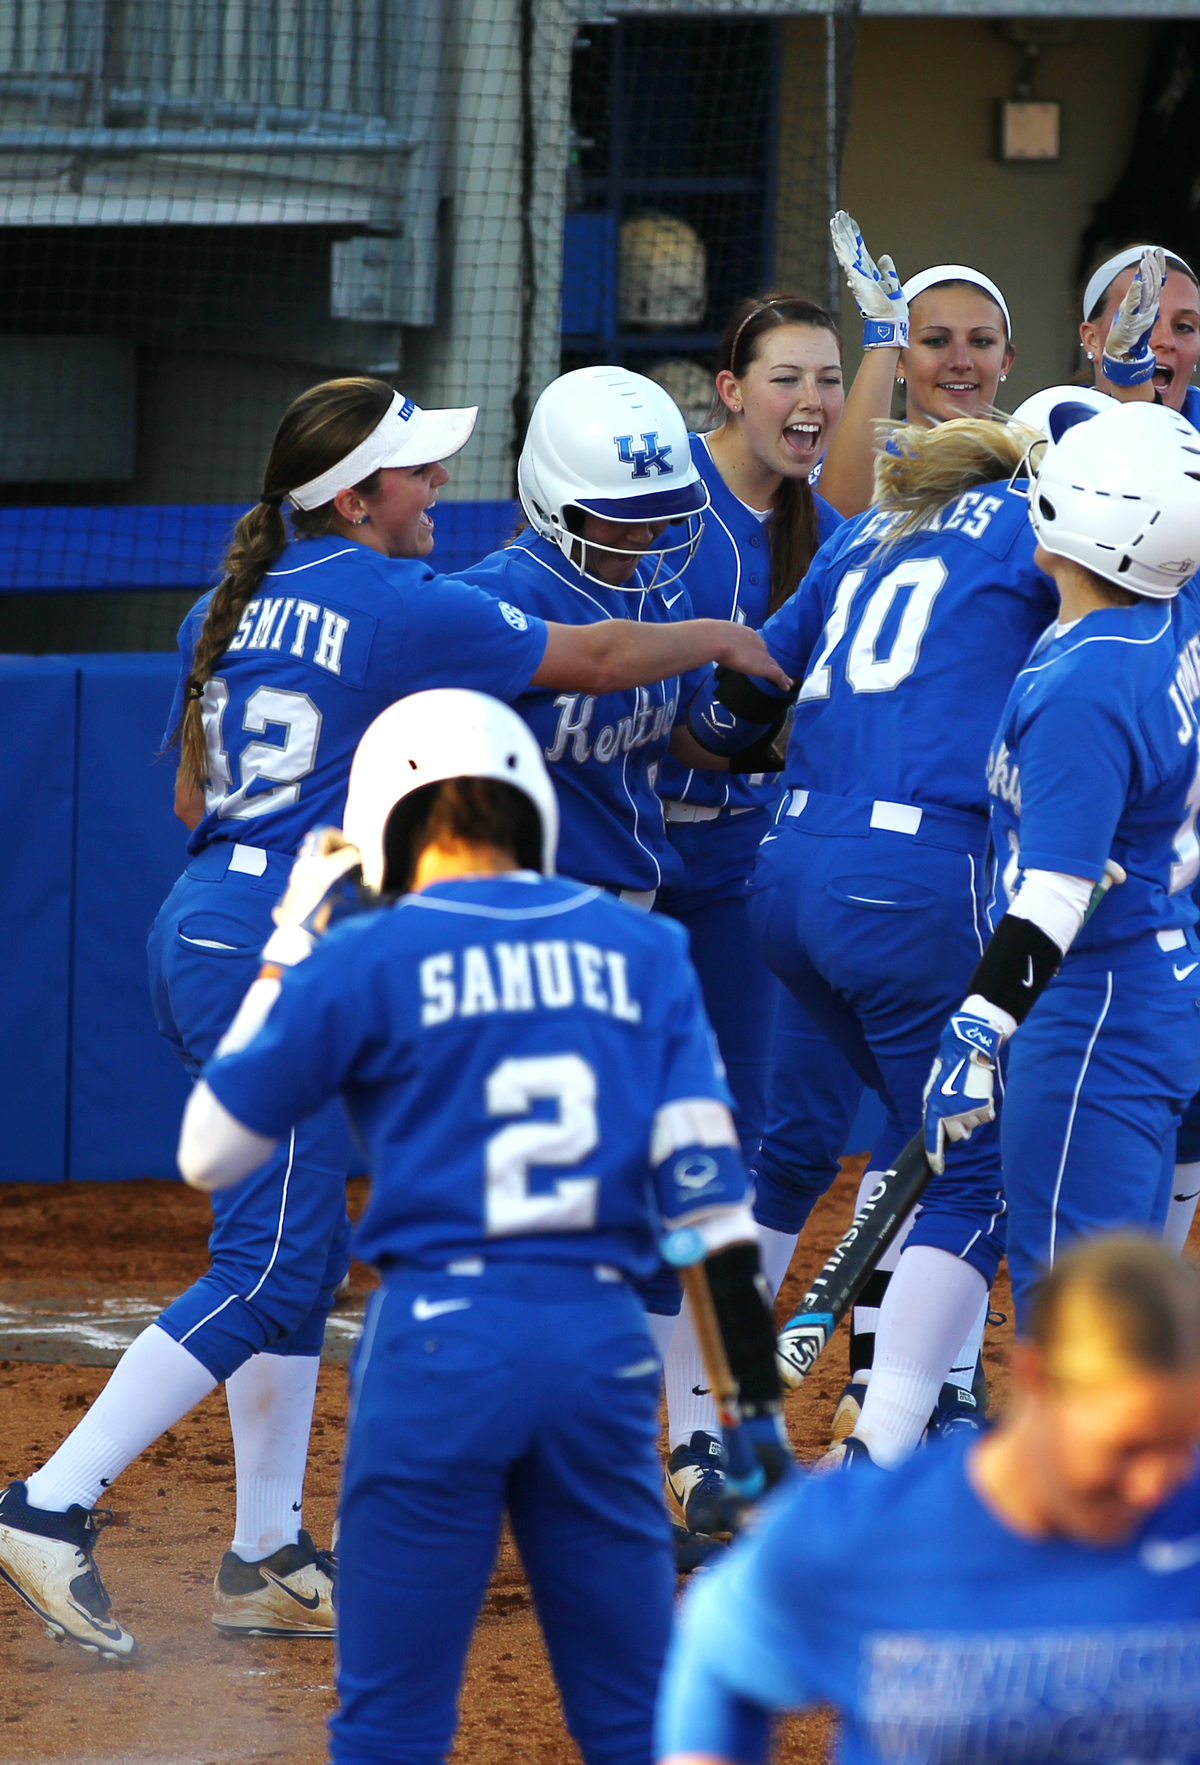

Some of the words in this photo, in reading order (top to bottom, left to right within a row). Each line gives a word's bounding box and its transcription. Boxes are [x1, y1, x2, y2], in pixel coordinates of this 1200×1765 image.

[613, 431, 674, 479] UK
[227, 597, 350, 676] SMITH
[797, 555, 950, 704] 10
[420, 939, 641, 1027] SAMUEL
[485, 1053, 598, 1238] 2
